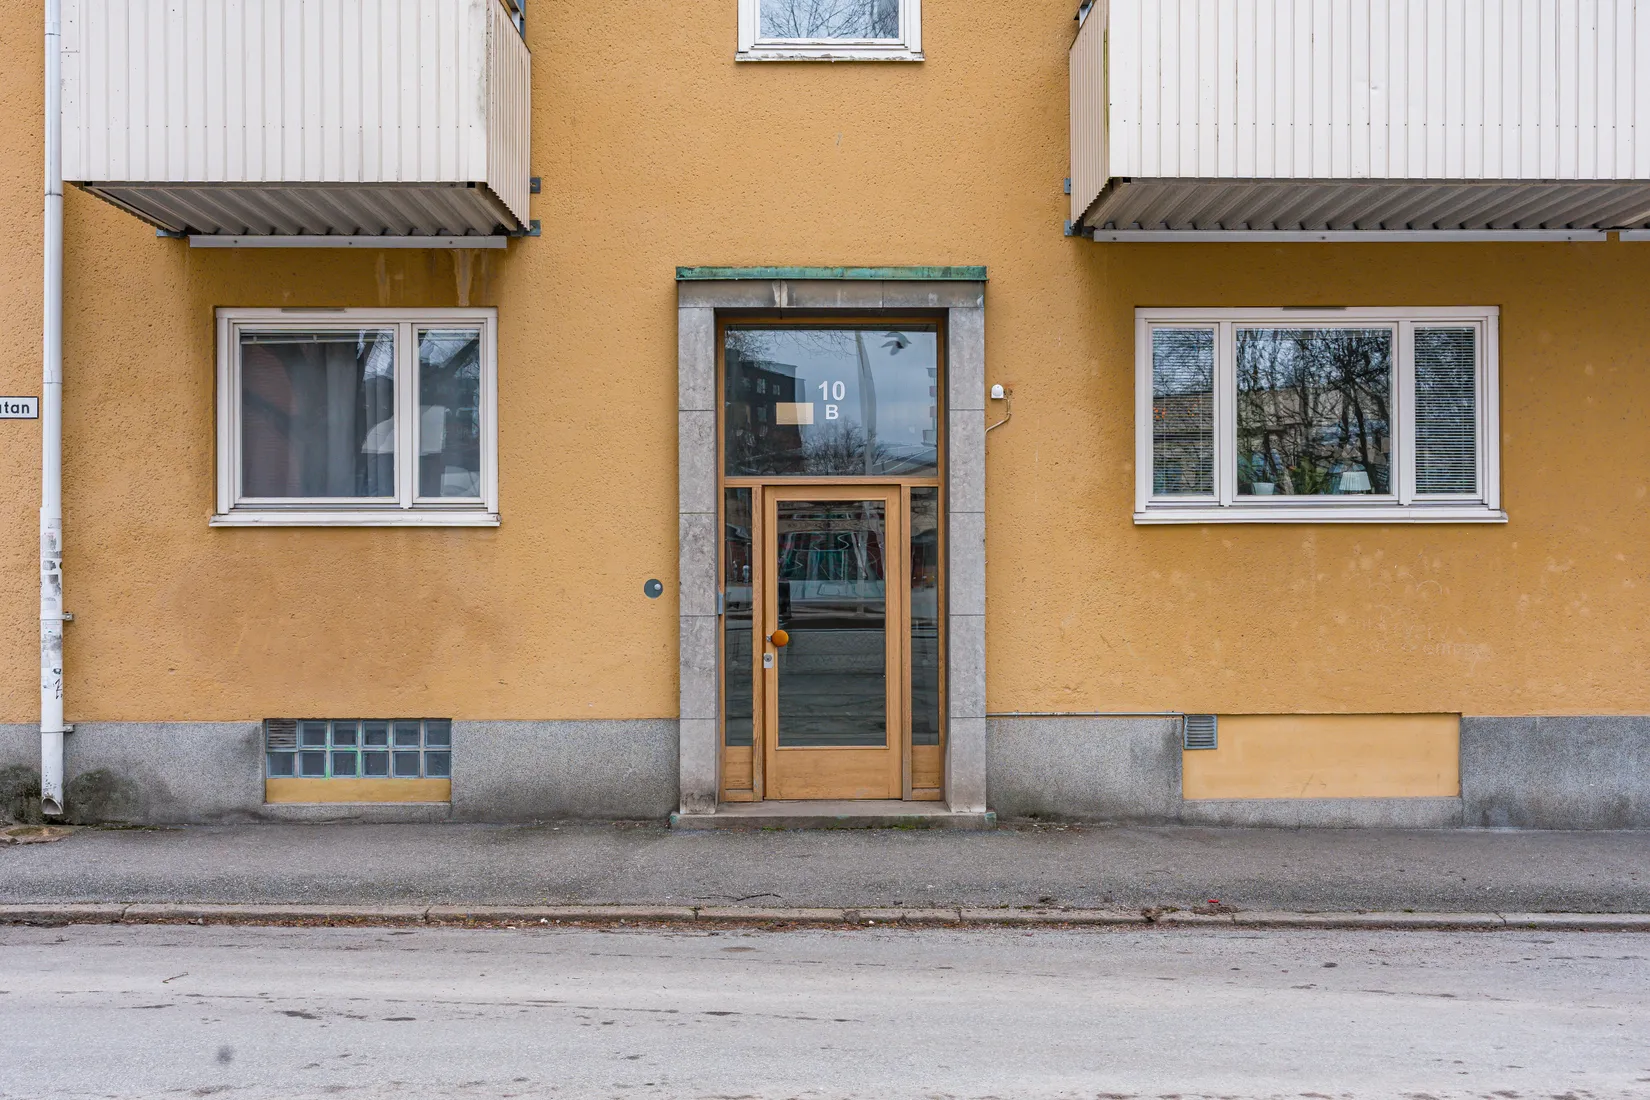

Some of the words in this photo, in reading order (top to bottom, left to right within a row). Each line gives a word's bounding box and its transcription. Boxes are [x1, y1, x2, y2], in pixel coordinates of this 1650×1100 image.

[818, 380, 846, 401] 10
[0, 401, 30, 414] tan
[825, 404, 839, 420] B
